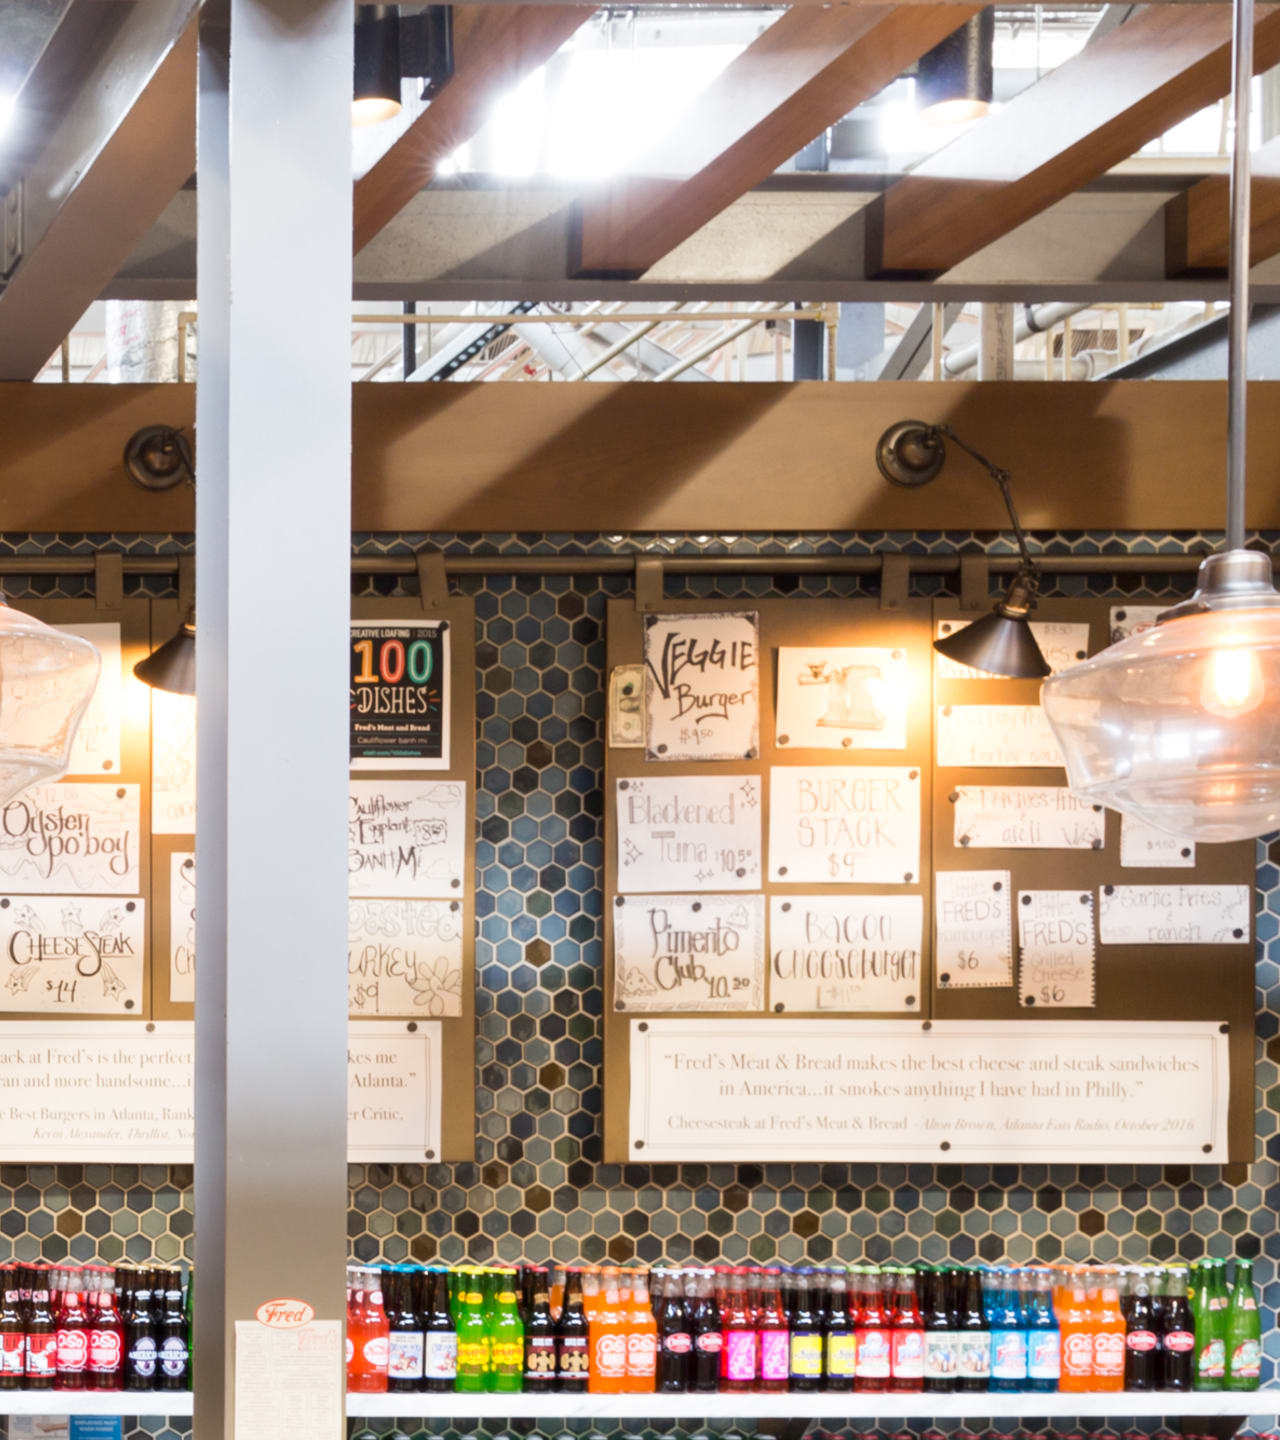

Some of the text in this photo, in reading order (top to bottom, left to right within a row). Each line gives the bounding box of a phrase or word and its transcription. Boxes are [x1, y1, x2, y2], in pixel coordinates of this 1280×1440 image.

[353, 639, 433, 684] 100
[645, 632, 756, 699] VEGGIE
[356, 686, 428, 714] DISHES
[669, 684, 752, 725] Burger
[628, 792, 735, 824] Blackened
[796, 778, 904, 813] BURGER
[796, 817, 896, 847] STACK
[651, 831, 707, 863] Tuna
[942, 896, 1002, 922] FRED'S
[647, 907, 740, 958] Pimento
[1022, 918, 1088, 946] FRED'S
[349, 944, 419, 985] URKEY
[957, 950, 980, 970] $6
[46, 979, 78, 1004] $14
[1041, 984, 1065, 1003] $6
[29, 1051, 42, 1064] at
[47, 1049, 94, 1064] Fred's
[98, 1050, 109, 1064] is
[113, 1049, 137, 1064] the
[375, 1054, 397, 1064] me
[730, 1054, 770, 1070] Meat
[775, 1055, 789, 1070] &
[795, 1054, 841, 1070] Bread
[847, 1055, 897, 1071] makes
[901, 1055, 926, 1071] the
[930, 1055, 965, 1071] best
[969, 1055, 1025, 1072] cheese
[1029, 1055, 1059, 1072] and
[1064, 1055, 1105, 1072] steak
[1109, 1055, 1200, 1073] sandwiches
[23, 1072, 51, 1088] and
[54, 1076, 91, 1088] more
[719, 1080, 734, 1096] in
[838, 1080, 900, 1097] smokes
[904, 1081, 975, 1102] anything
[980, 1081, 985, 1097] I
[991, 1081, 1027, 1098] have
[1031, 1081, 1060, 1098] had
[1065, 1082, 1081, 1098] in
[10, 1106, 37, 1121] Best
[40, 1107, 91, 1125] Burgers
[93, 1107, 106, 1121] in
[668, 1115, 751, 1130] Cheesesteak
[754, 1117, 766, 1130] at
[770, 1115, 812, 1130] Fred's
[815, 1116, 848, 1130] Meat
[852, 1116, 863, 1130] &
[869, 1116, 908, 1130] Bread
[265, 1302, 306, 1323] Fred
